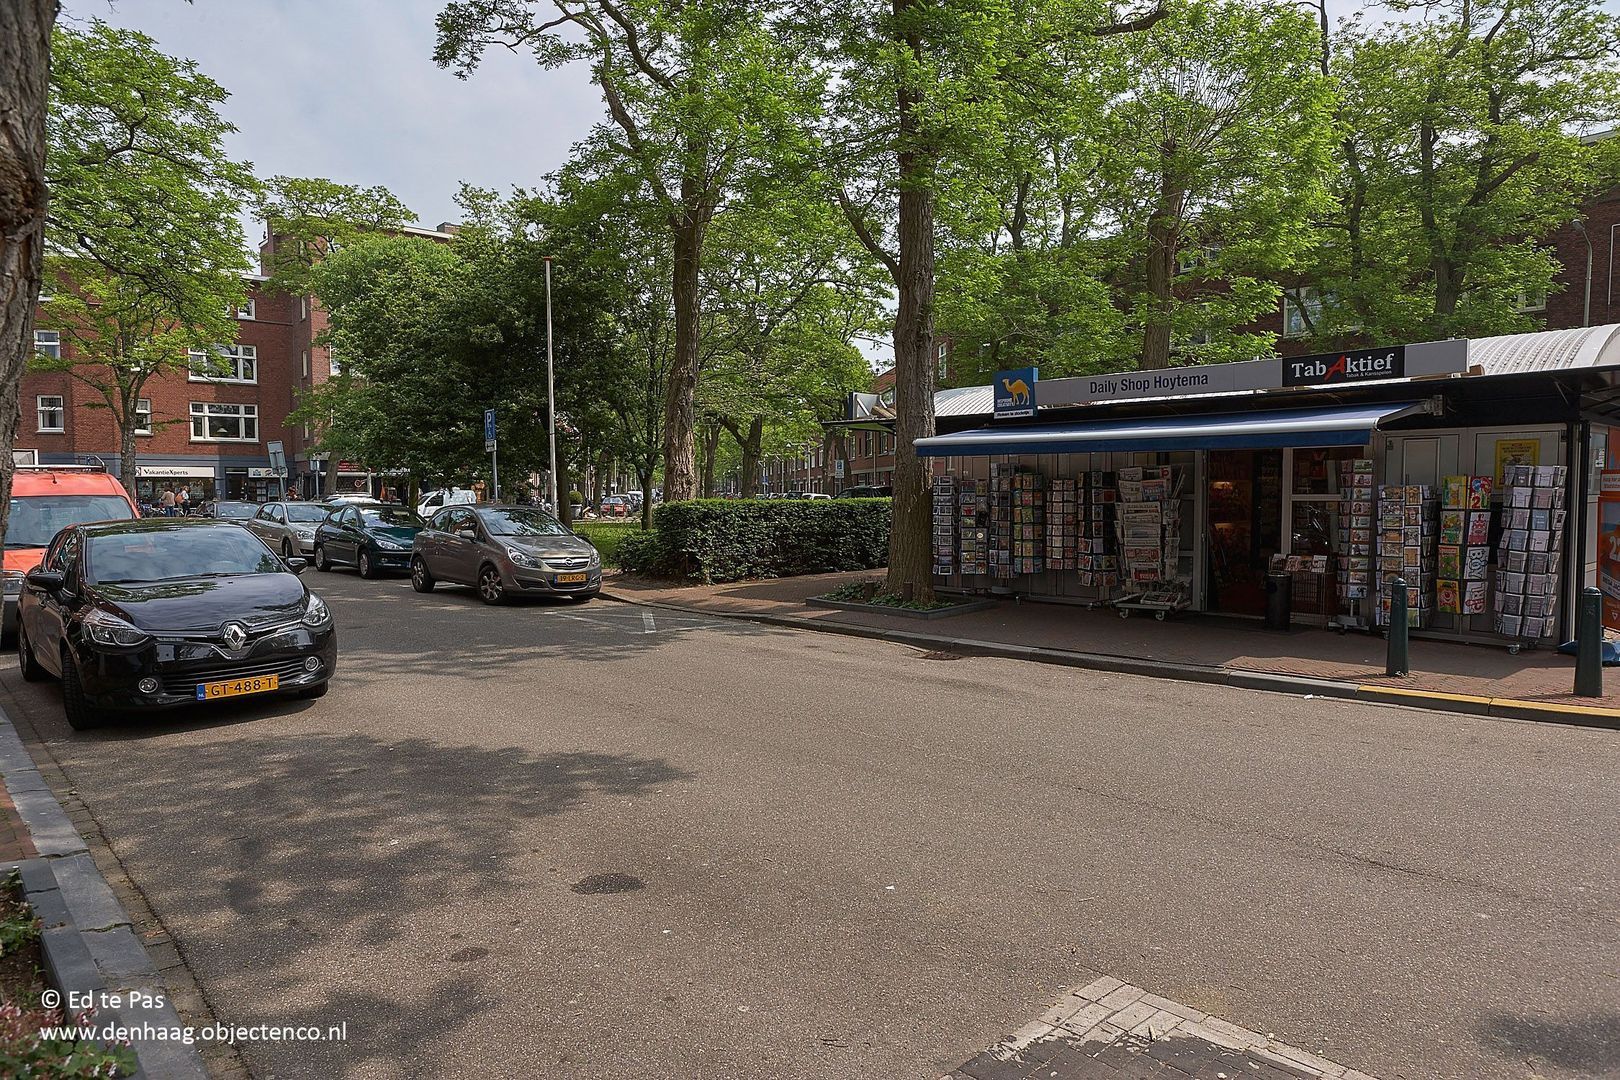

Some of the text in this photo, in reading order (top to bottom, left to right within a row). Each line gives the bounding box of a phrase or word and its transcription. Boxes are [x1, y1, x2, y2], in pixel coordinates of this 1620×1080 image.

[1291, 353, 1395, 382] TabAktief
[1090, 374, 1209, 395] Daily Shop Hoytema
[143, 468, 189, 476] VakantieXperts
[211, 677, 274, 696] GT-488-T
